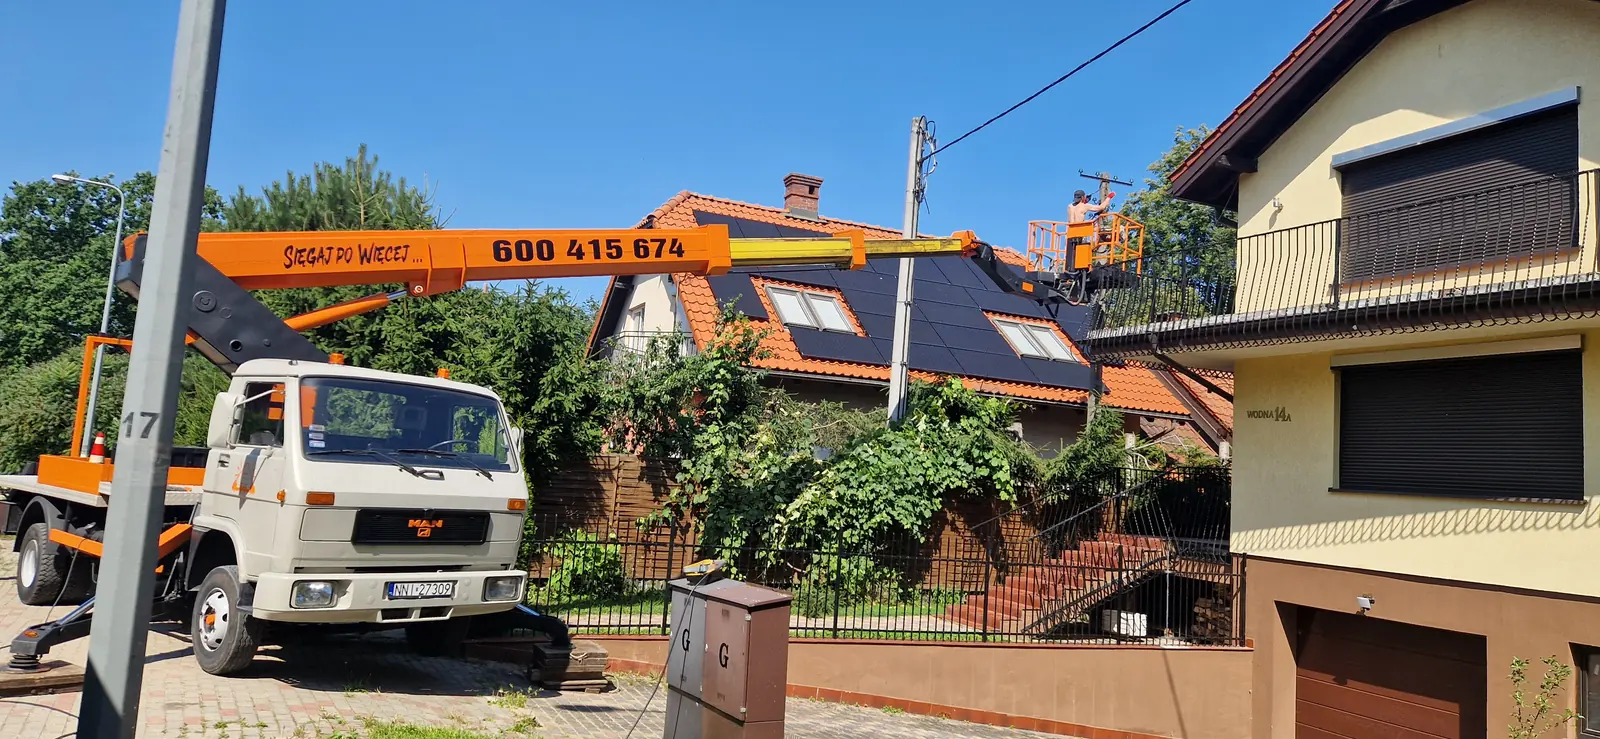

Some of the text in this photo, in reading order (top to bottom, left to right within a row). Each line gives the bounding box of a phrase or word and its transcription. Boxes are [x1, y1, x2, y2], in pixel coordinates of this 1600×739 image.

[336, 246, 353, 264] PO
[492, 238, 685, 263] 600 415 674
[122, 411, 161, 439] 17
[1246, 410, 1274, 419] WODNA
[408, 519, 444, 528] MAN
[419, 583, 451, 596] 27309
[681, 628, 691, 652] G
[719, 642, 730, 670] G
